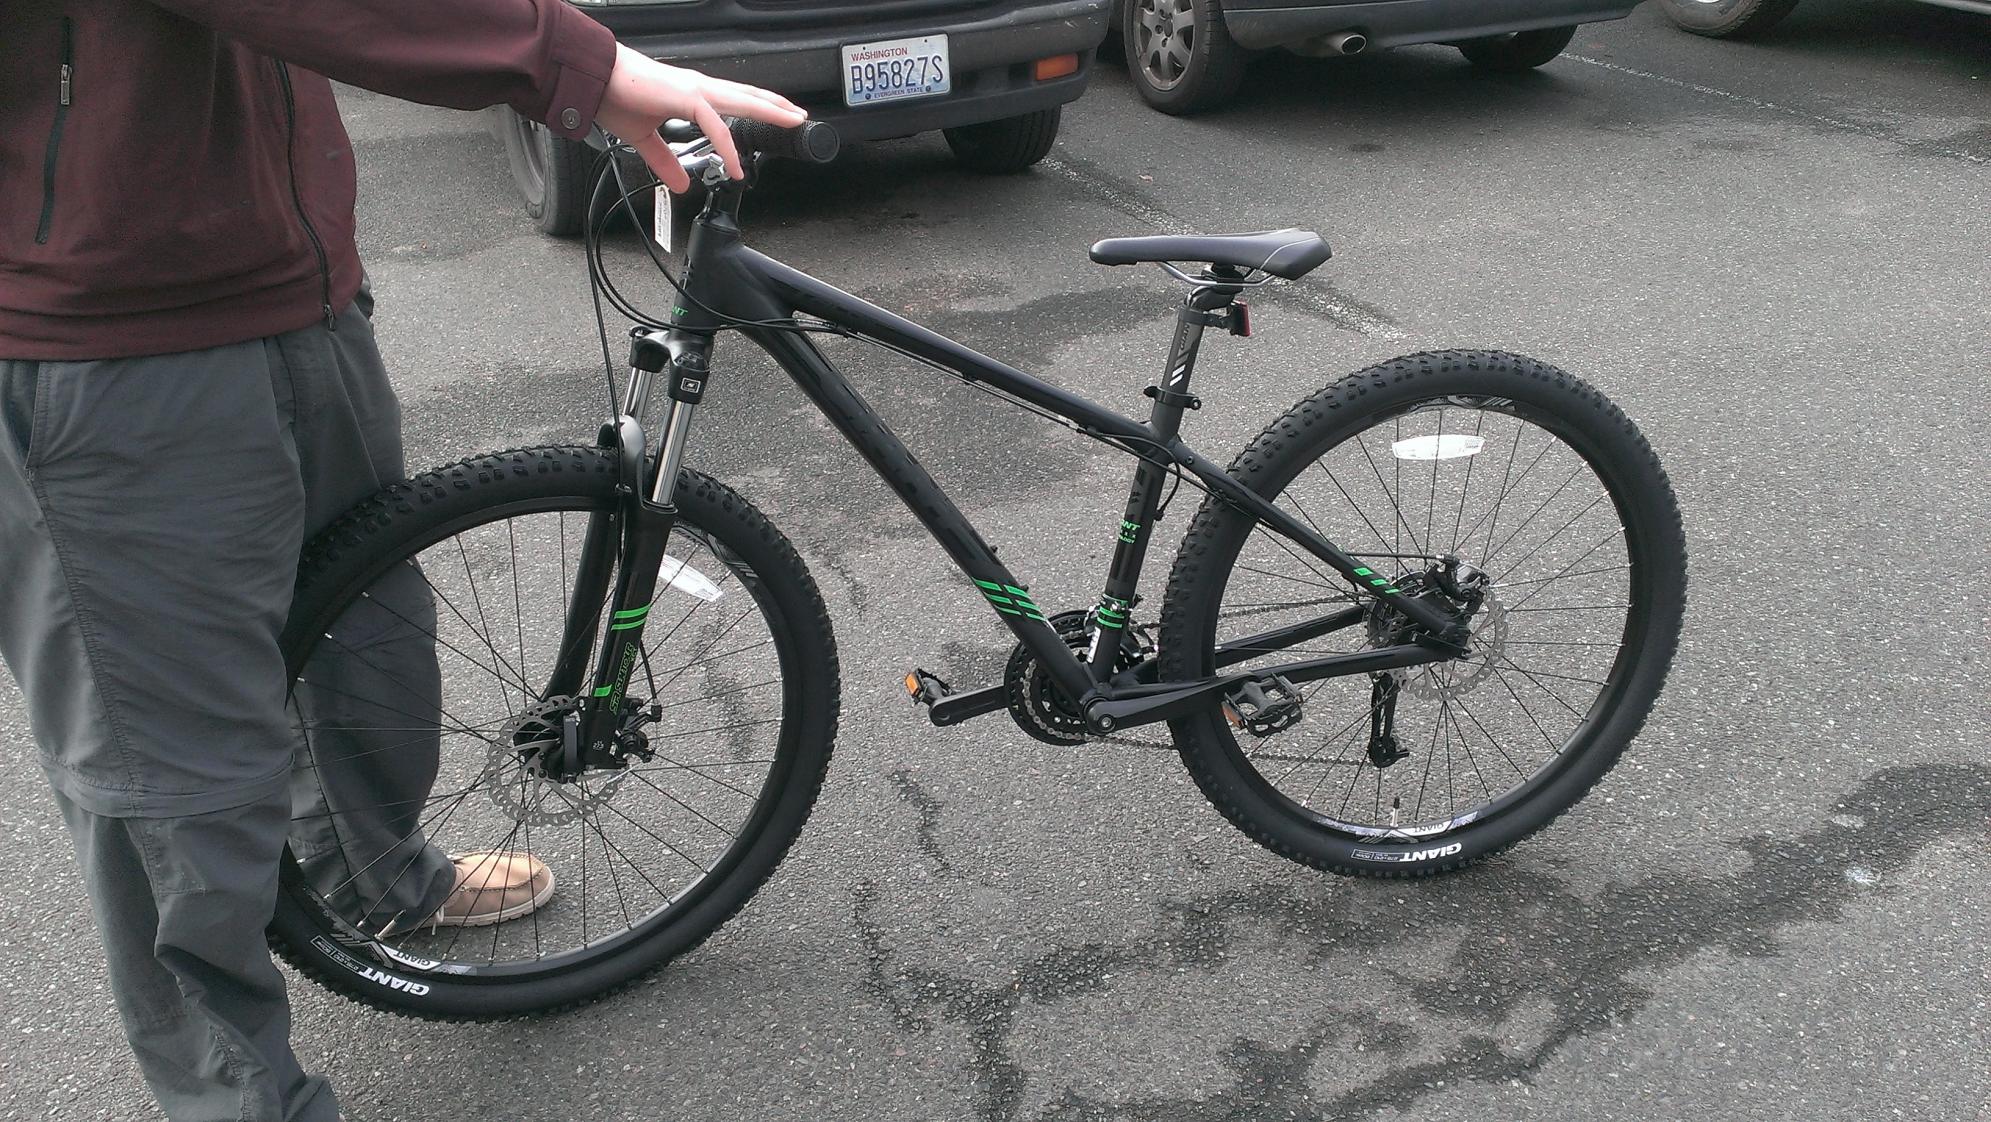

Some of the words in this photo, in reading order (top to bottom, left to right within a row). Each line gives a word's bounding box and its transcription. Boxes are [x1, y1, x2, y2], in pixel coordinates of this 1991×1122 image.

[851, 47, 908, 62] WASHINGTON
[850, 55, 944, 94] B95827S
[874, 89, 905, 99] EVERGREEN
[1414, 823, 1444, 833] GIANT
[1399, 842, 1463, 862] GIANT
[393, 951, 431, 966] GIANT
[358, 966, 430, 997] GIANT
